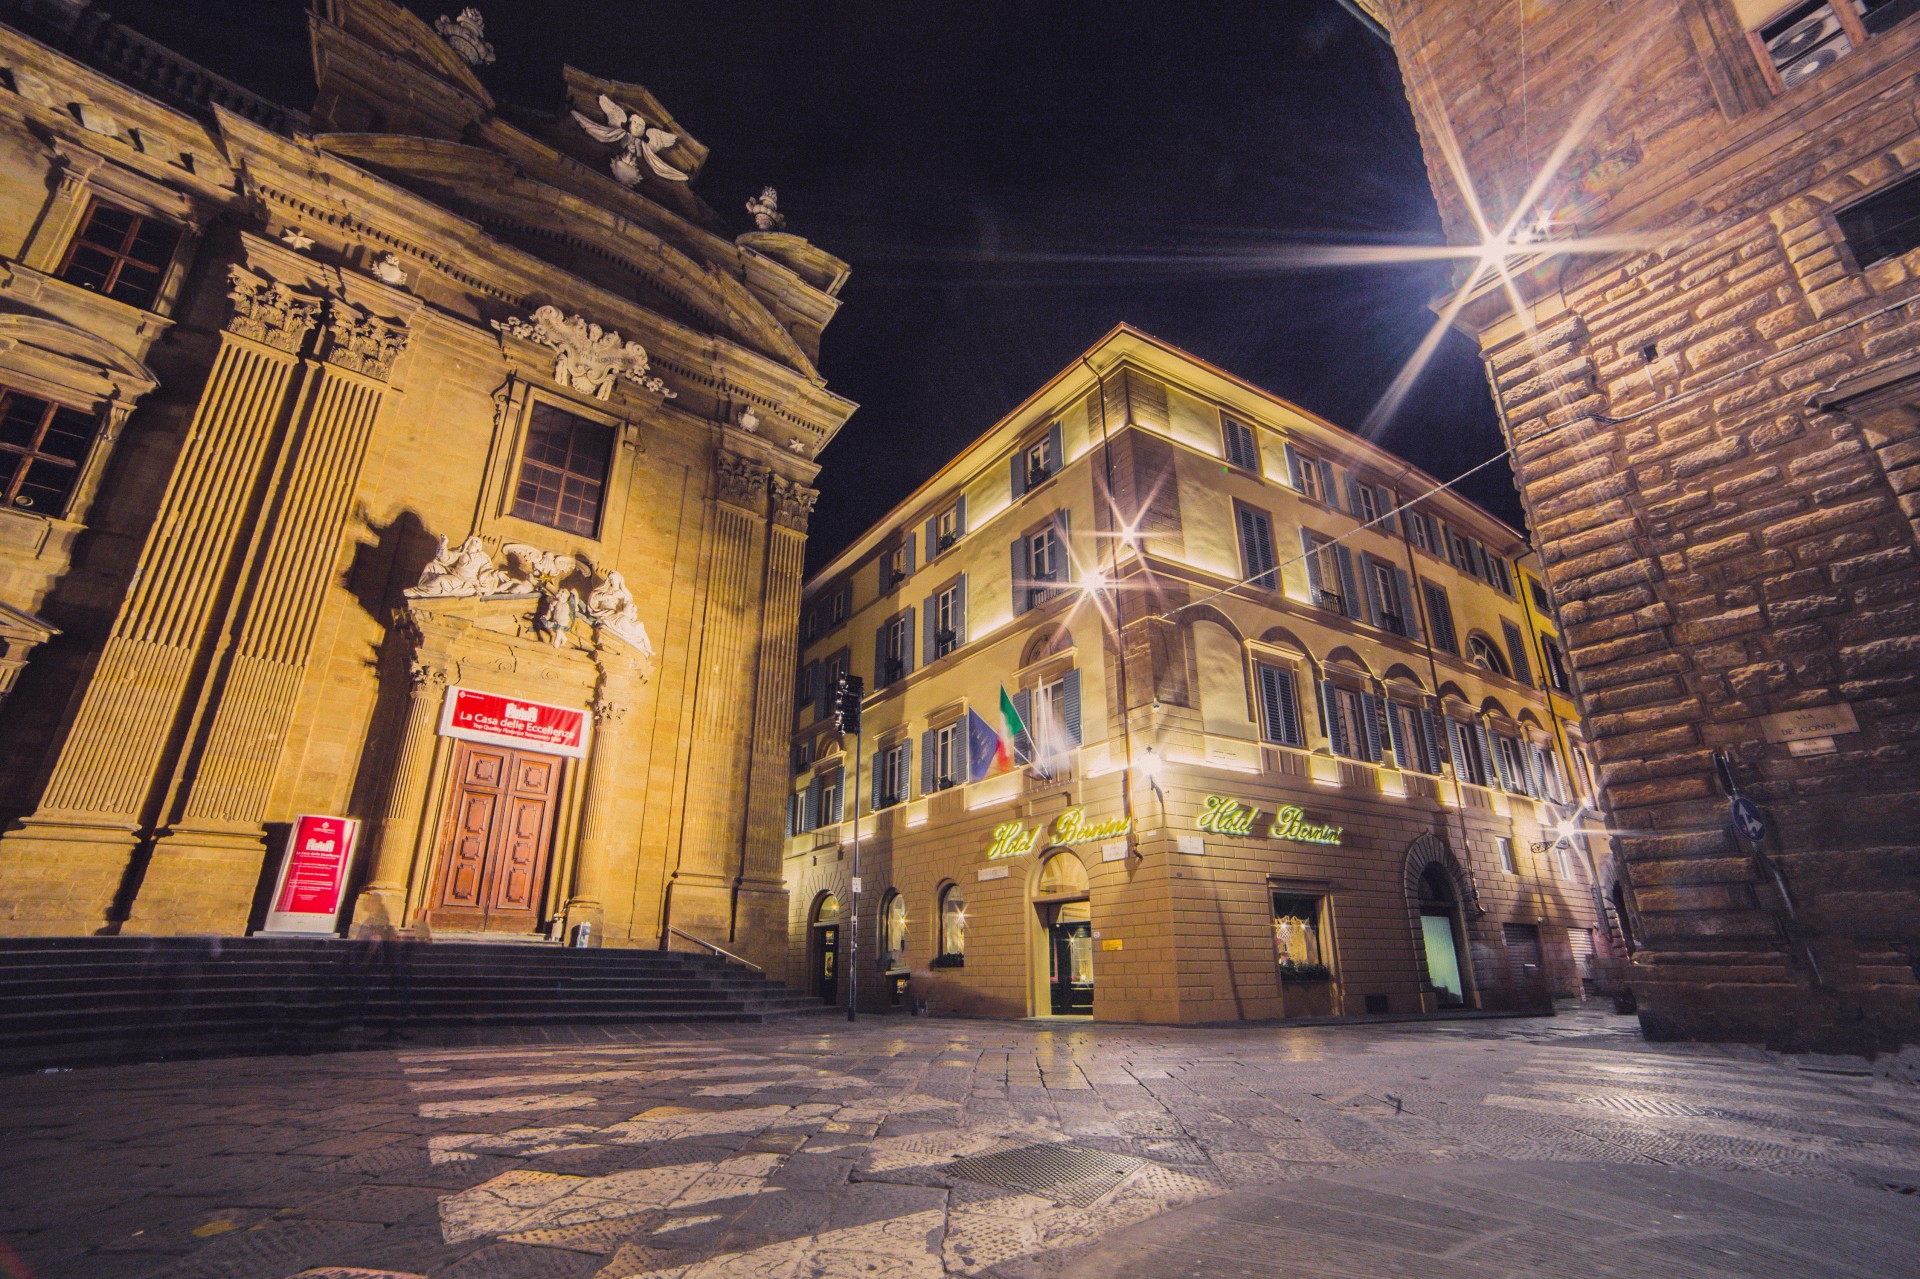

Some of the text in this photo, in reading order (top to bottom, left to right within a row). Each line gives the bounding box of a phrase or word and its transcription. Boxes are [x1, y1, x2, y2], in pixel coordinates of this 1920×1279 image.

[460, 711, 575, 738] La Casa delle Eccellenze
[1800, 723, 1837, 732] GONDI
[988, 808, 1132, 860] Hotel Bernini
[1197, 795, 1343, 846] Hotel Bernini
